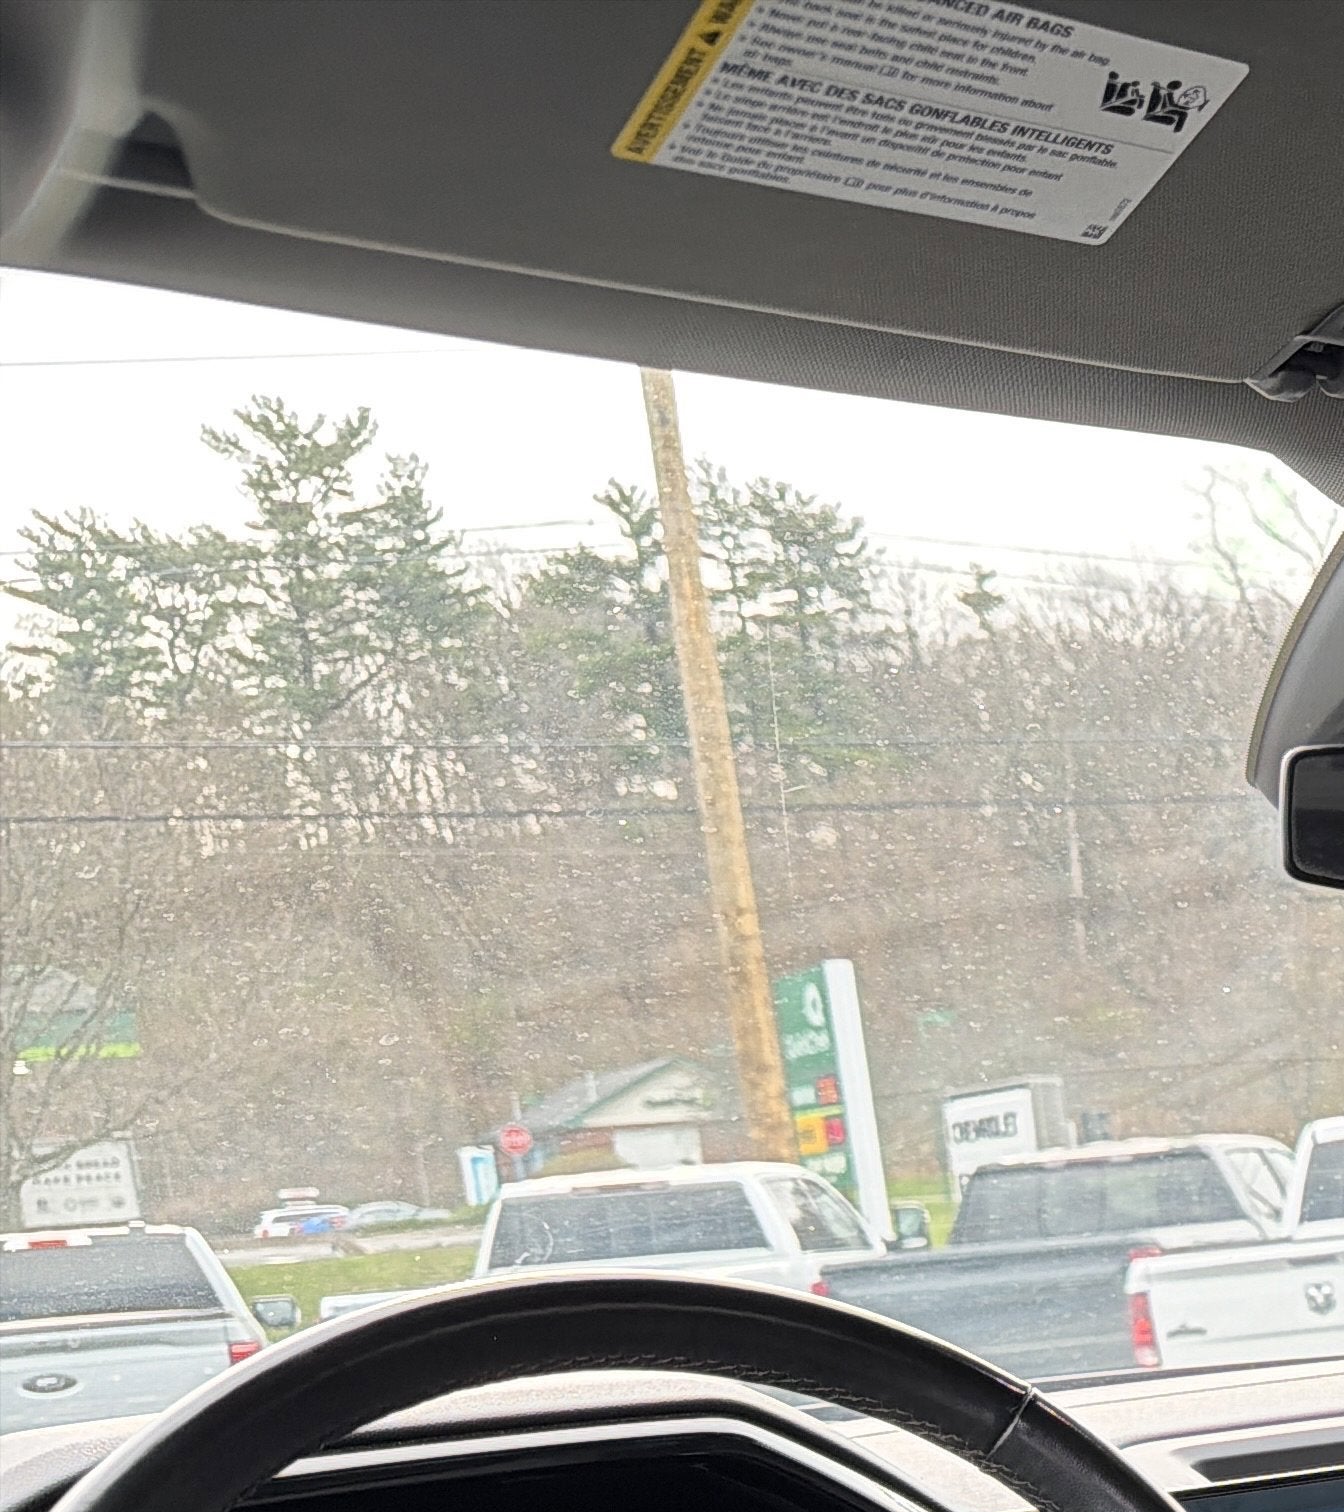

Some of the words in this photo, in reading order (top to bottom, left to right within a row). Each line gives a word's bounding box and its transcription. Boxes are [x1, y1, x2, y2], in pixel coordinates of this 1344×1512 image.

[992, 9, 1023, 24] AIR
[1026, 17, 1073, 37] BAGS
[972, 41, 988, 50] for
[992, 30, 1033, 45] injured
[1034, 39, 1048, 52] by
[1050, 44, 1069, 54] the
[980, 58, 998, 69] the
[901, 71, 918, 81] for
[954, 83, 1018, 103] information
[1021, 99, 1054, 111] about
[777, 75, 822, 93] AVEC
[825, 85, 859, 100] DES
[862, 93, 906, 111] SACS
[910, 104, 1008, 132] GONFLABLES
[1012, 126, 1113, 154] INTELLIGENTS
